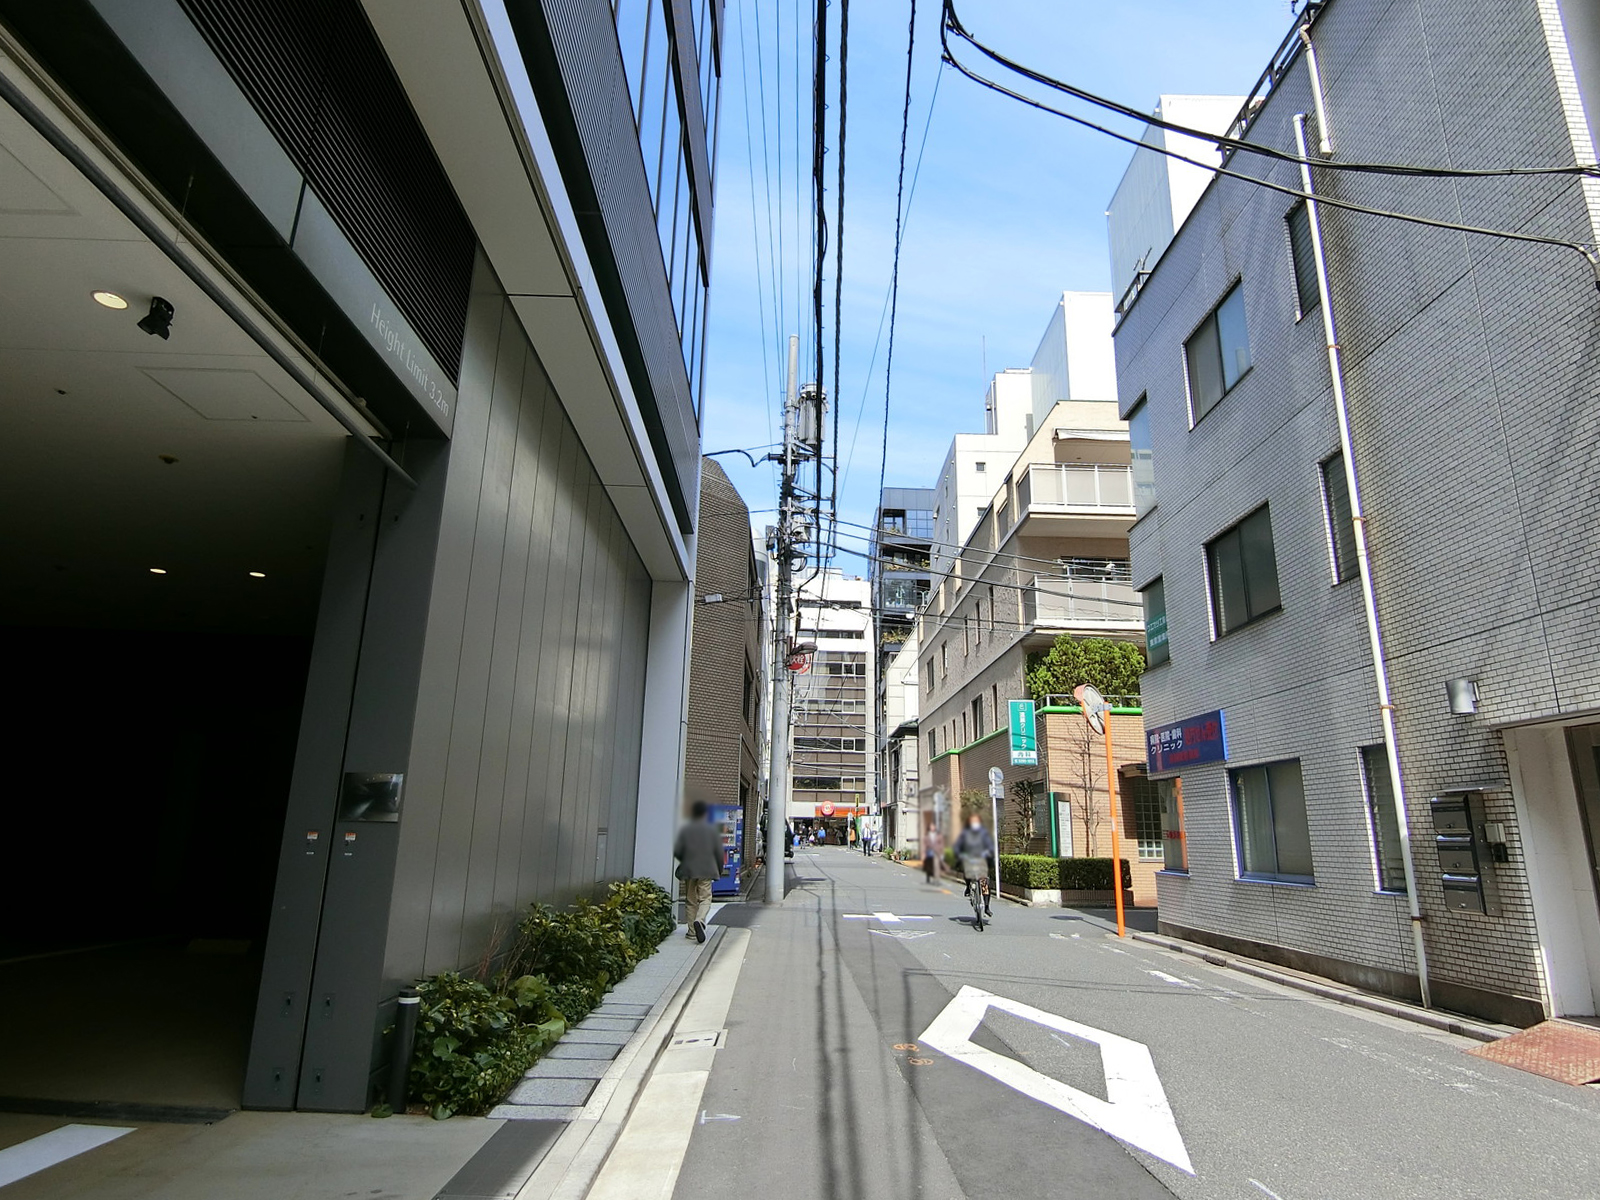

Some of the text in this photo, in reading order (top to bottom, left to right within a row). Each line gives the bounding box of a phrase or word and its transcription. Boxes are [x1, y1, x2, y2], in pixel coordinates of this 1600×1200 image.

[370, 302, 450, 417] Height Limit 3.2m
[1151, 740, 1183, 755] クリニック
